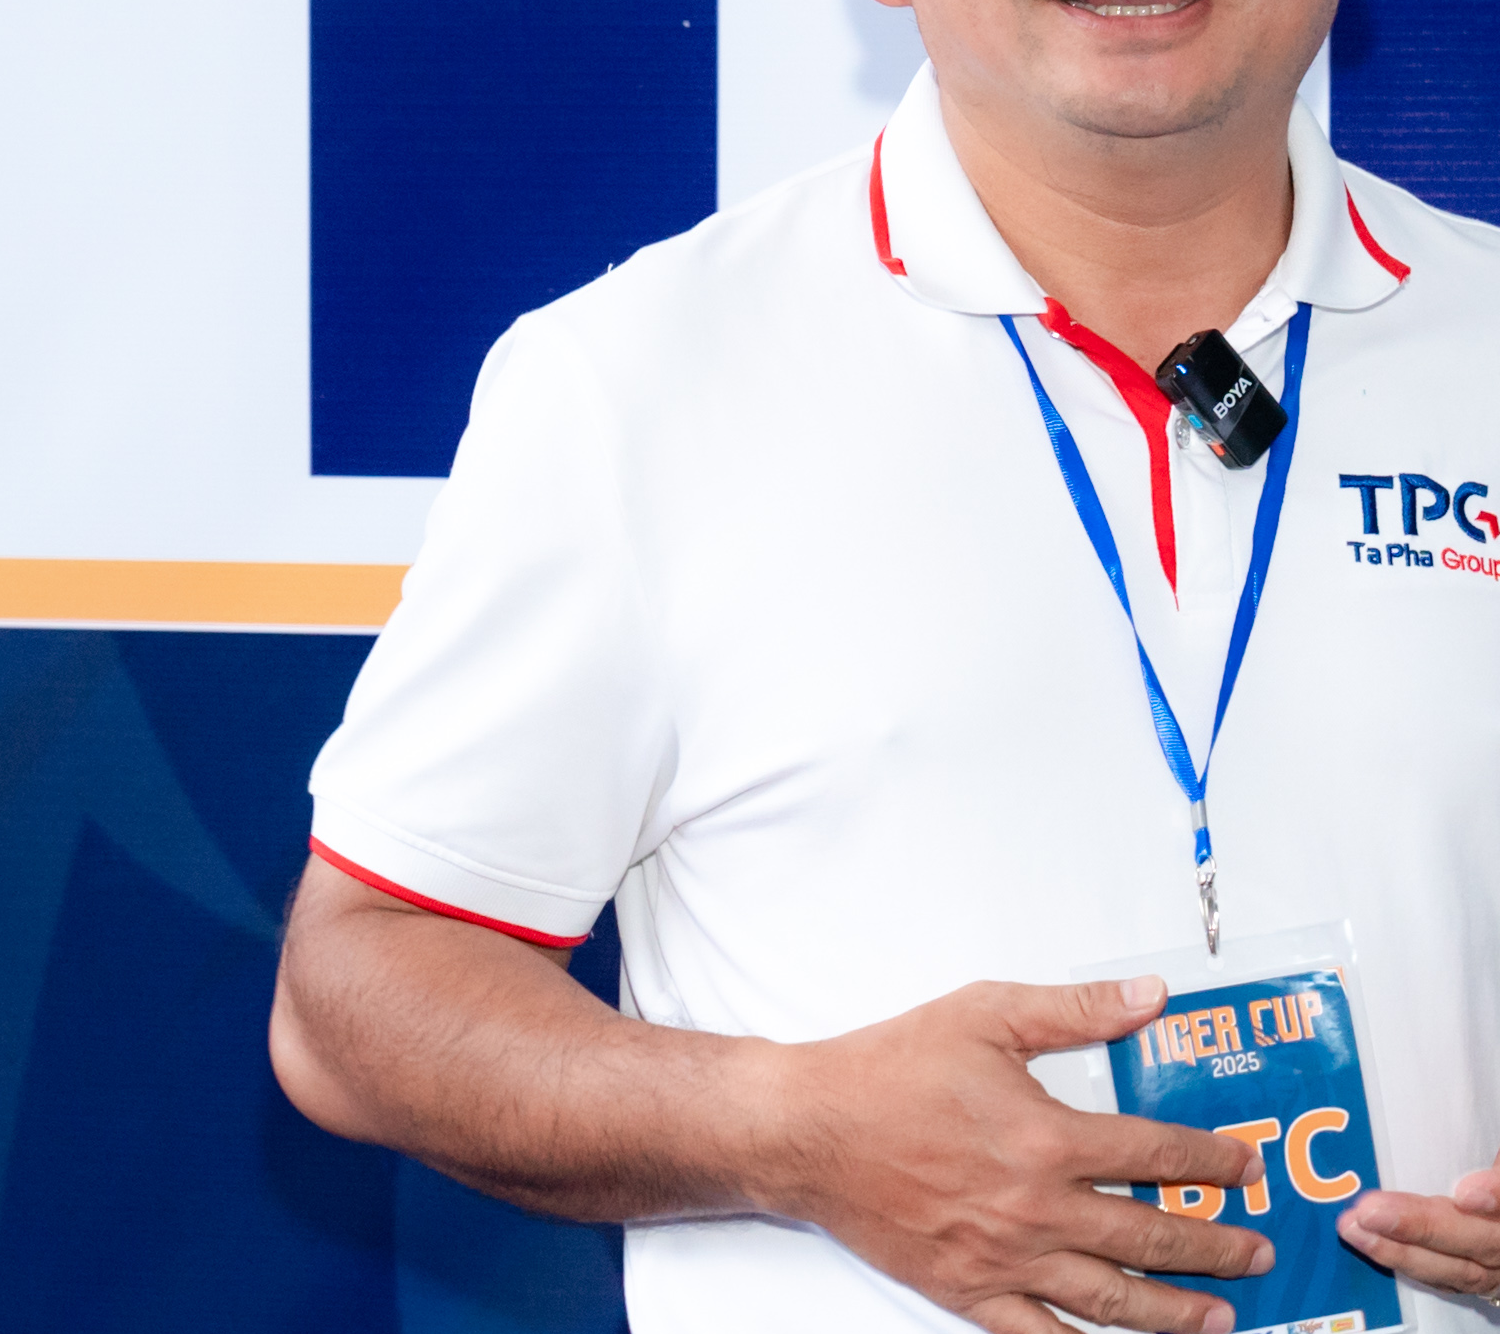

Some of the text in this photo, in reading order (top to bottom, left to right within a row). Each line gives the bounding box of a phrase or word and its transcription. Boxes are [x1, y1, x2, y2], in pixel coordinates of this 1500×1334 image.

[1213, 377, 1252, 419] BOYA
[1346, 541, 1382, 565] Ta
[1386, 542, 1434, 568] Pha
[1249, 990, 1324, 1047] CUP
[1211, 1051, 1261, 1078] 2025
